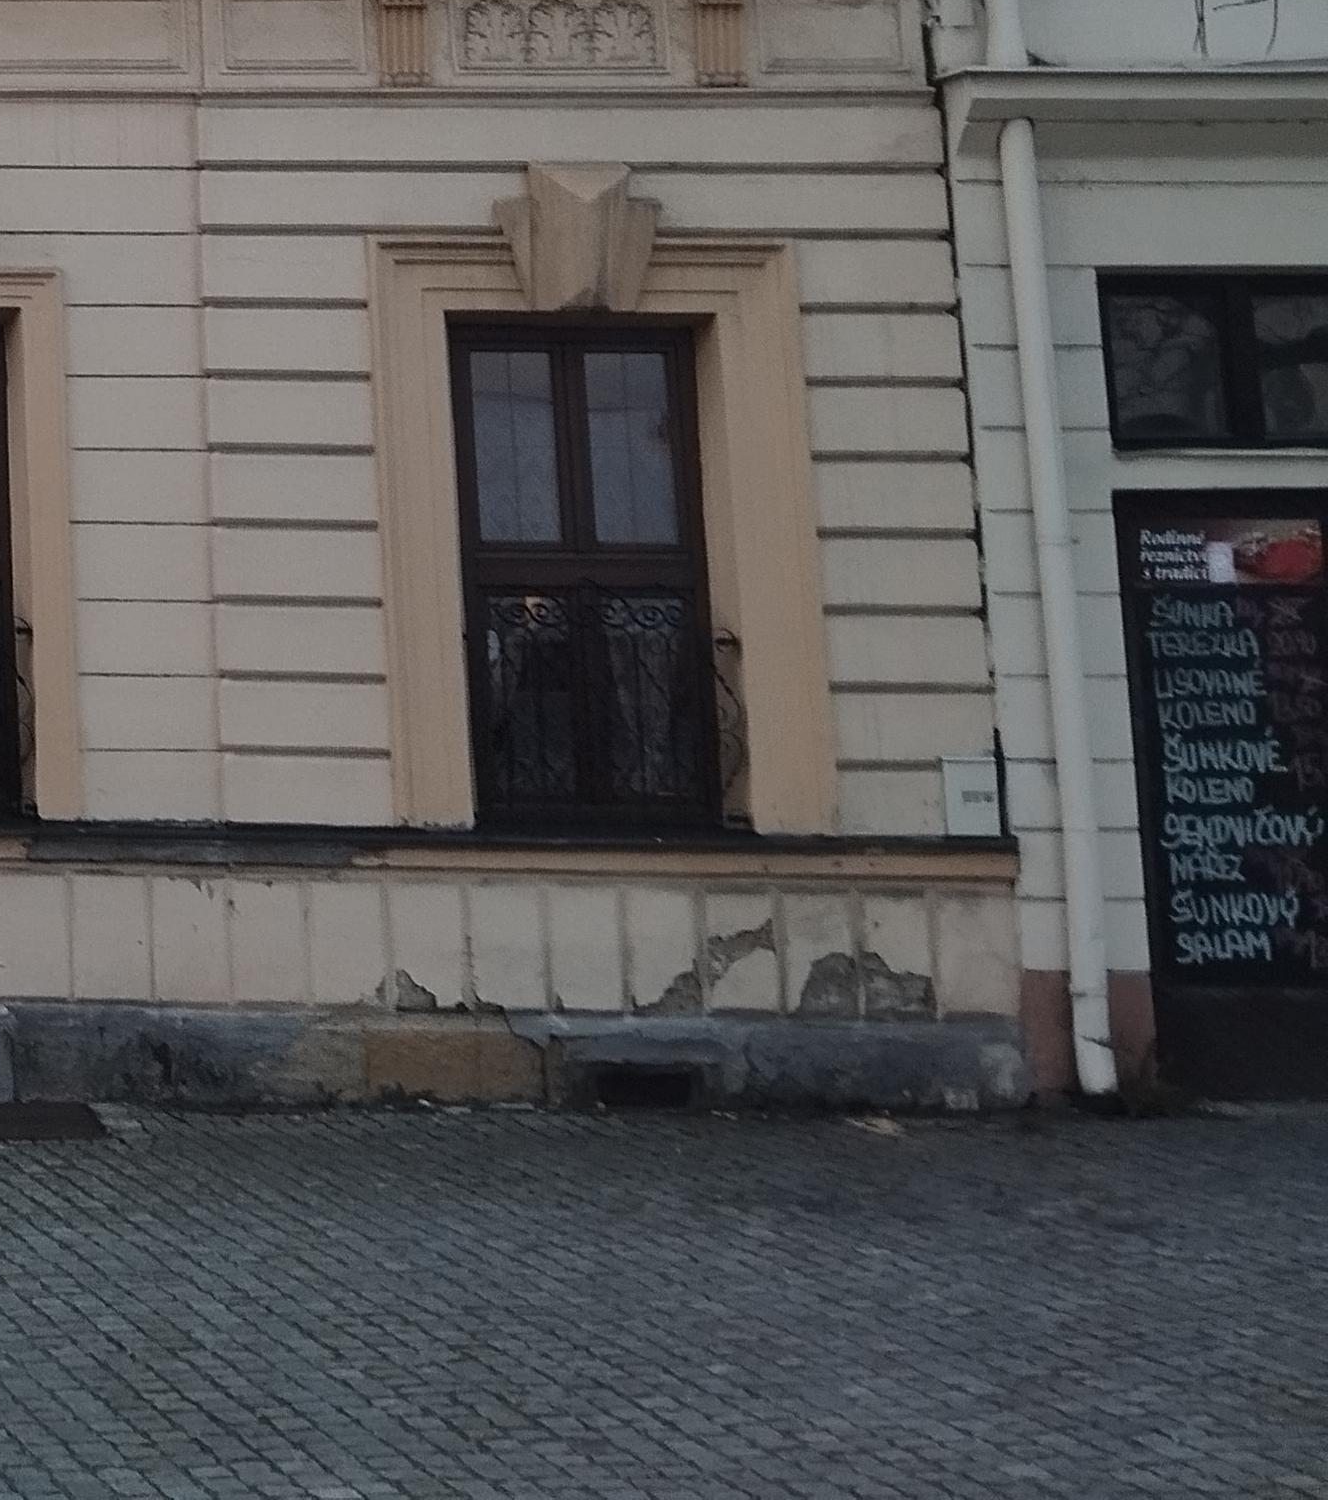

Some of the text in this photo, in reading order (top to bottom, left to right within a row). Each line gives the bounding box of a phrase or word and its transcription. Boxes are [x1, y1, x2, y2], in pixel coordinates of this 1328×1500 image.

[1148, 593, 1235, 629] ŠUNKA
[1157, 699, 1257, 730] KOLENO
[1162, 727, 1289, 773] ŠUNKOVÉ
[1166, 773, 1255, 804] KOLENO
[1168, 886, 1301, 928] ŠUNKOVÝ
